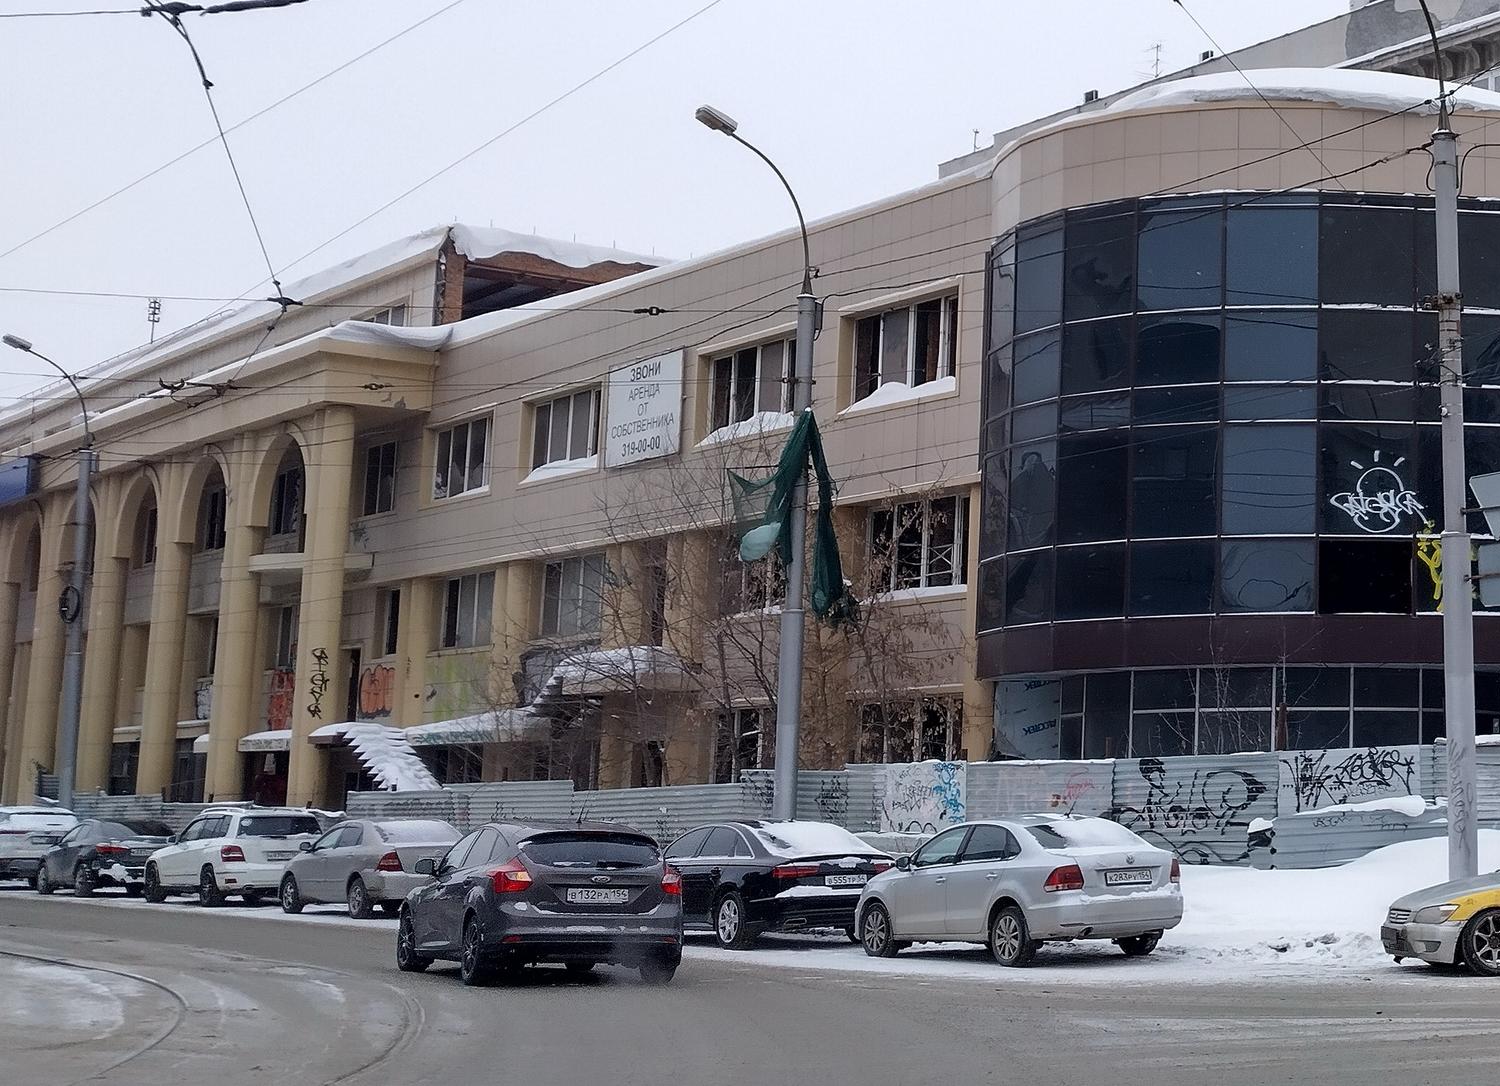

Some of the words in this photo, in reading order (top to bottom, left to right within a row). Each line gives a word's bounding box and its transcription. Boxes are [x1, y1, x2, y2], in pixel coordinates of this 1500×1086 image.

[630, 362, 662, 382] ЗВОНИ
[628, 383, 660, 401] АРЕНДА
[637, 402, 649, 416] ОТ
[611, 412, 675, 439] СОБСТВЕННИКА
[621, 435, 661, 457] 319-00-00
[570, 889, 609, 900] В132РА
